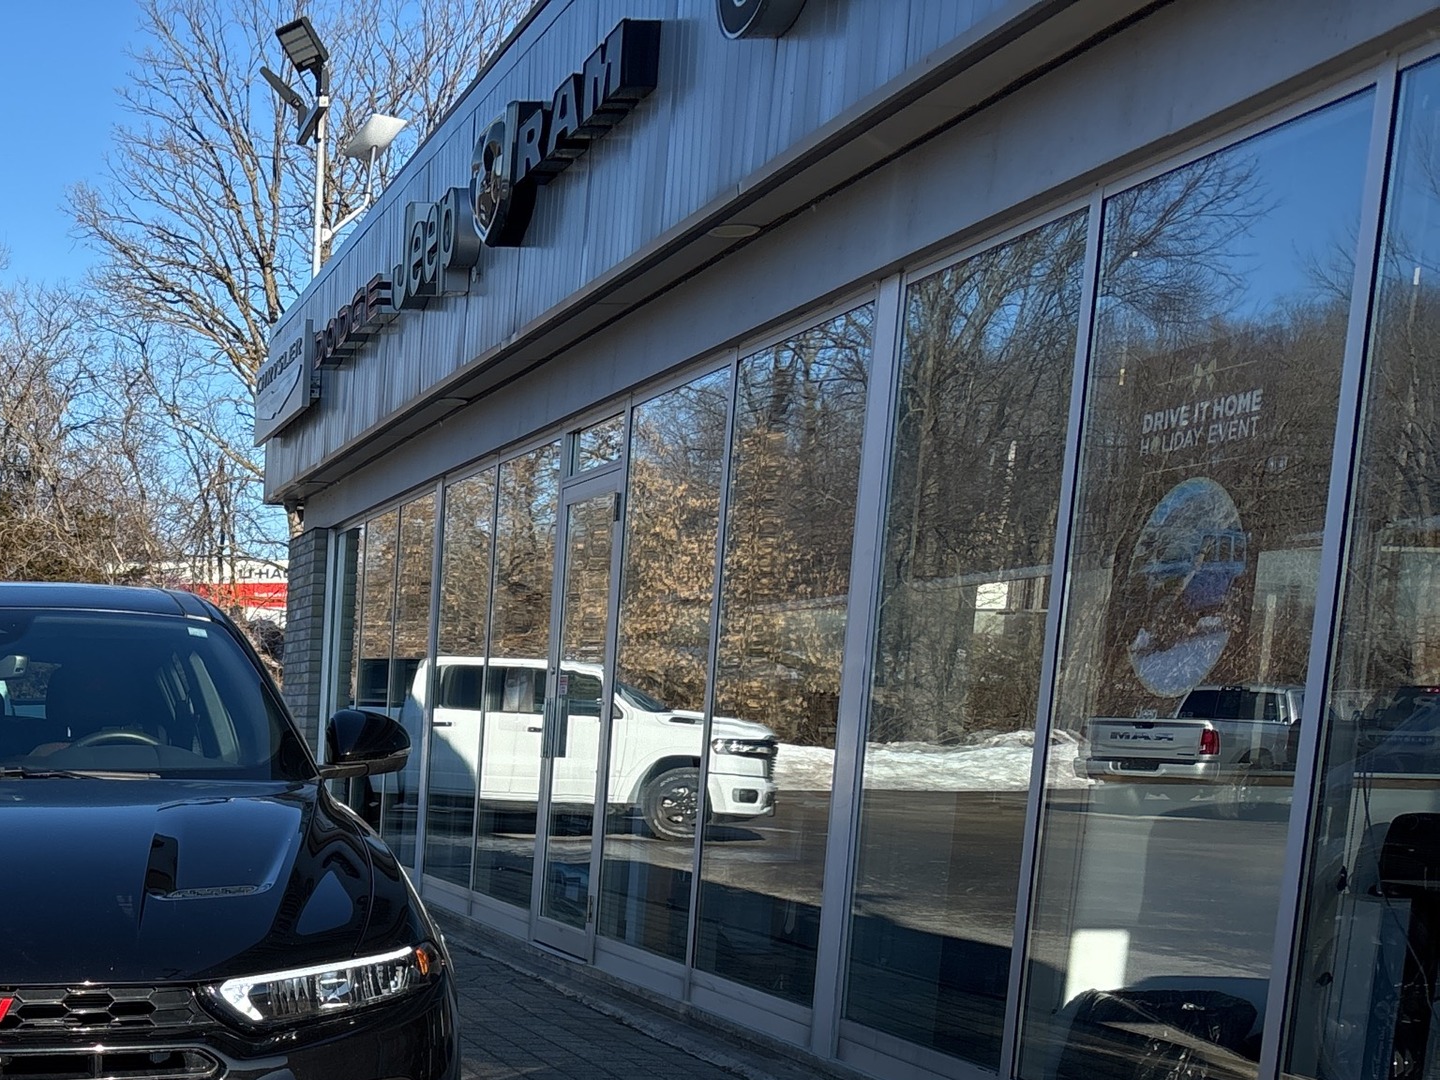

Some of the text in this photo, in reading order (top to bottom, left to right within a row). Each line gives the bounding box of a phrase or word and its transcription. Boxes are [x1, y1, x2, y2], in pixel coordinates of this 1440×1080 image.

[516, 19, 625, 184] RAM
[392, 187, 456, 311] Jeep
[314, 274, 391, 370] DODGE
[256, 337, 303, 396] CHRYSLER
[1139, 415, 1261, 457] HOLIDAY EVENT
[1142, 388, 1264, 434] DRIVE IT HOME
[240, 568, 288, 579] U-HA
